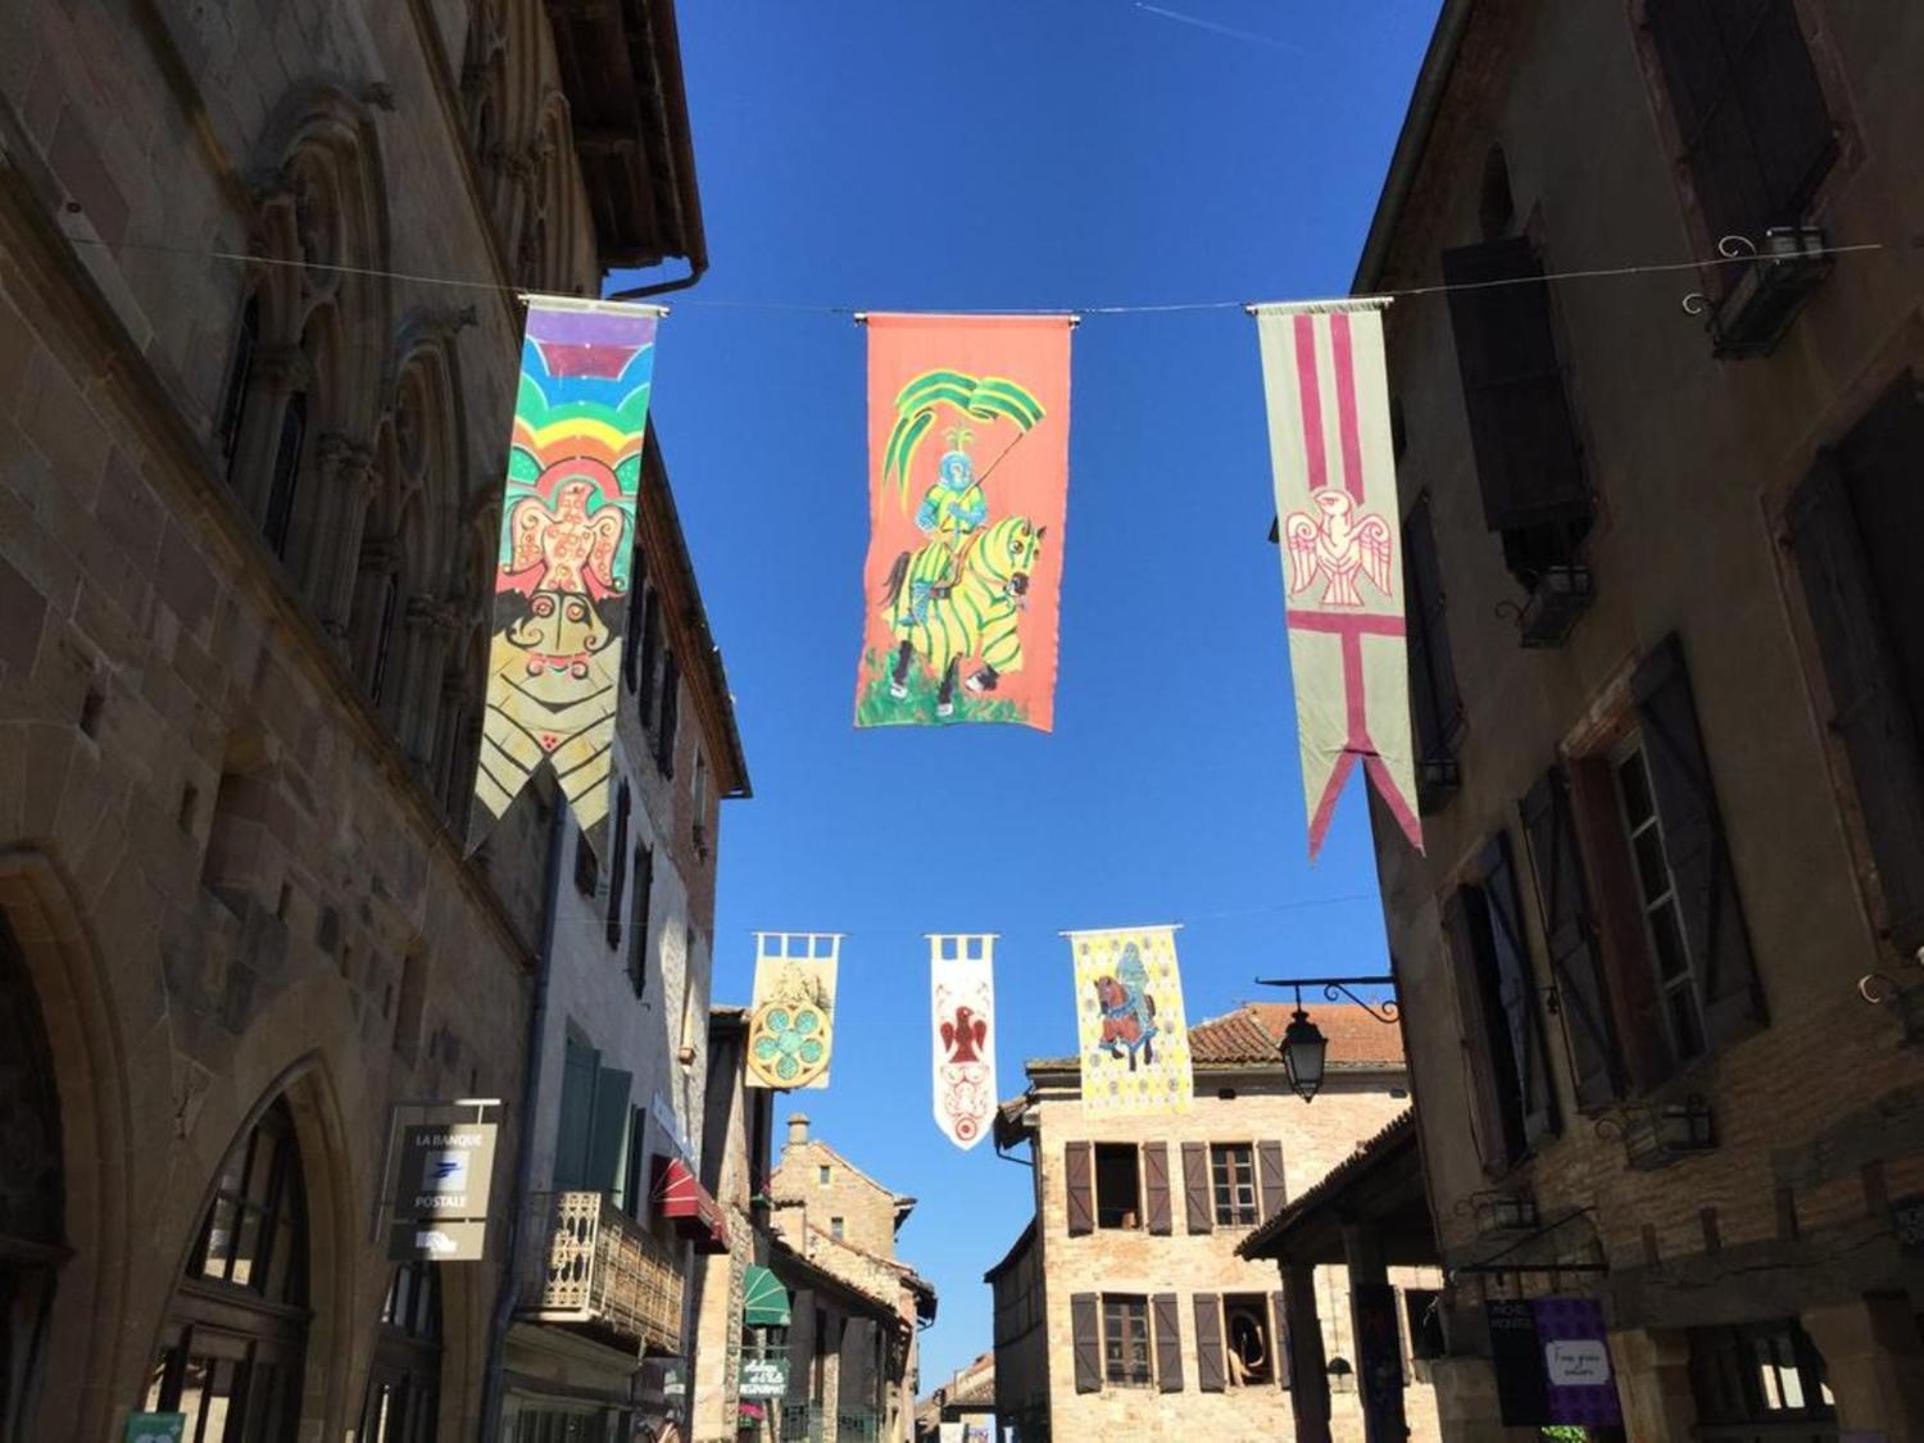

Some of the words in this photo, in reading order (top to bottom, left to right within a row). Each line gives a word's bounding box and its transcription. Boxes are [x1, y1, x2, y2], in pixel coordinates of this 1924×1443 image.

[415, 1134, 431, 1147] LA
[432, 1134, 483, 1147] BANQUE
[414, 1196, 467, 1208] POSTALE
